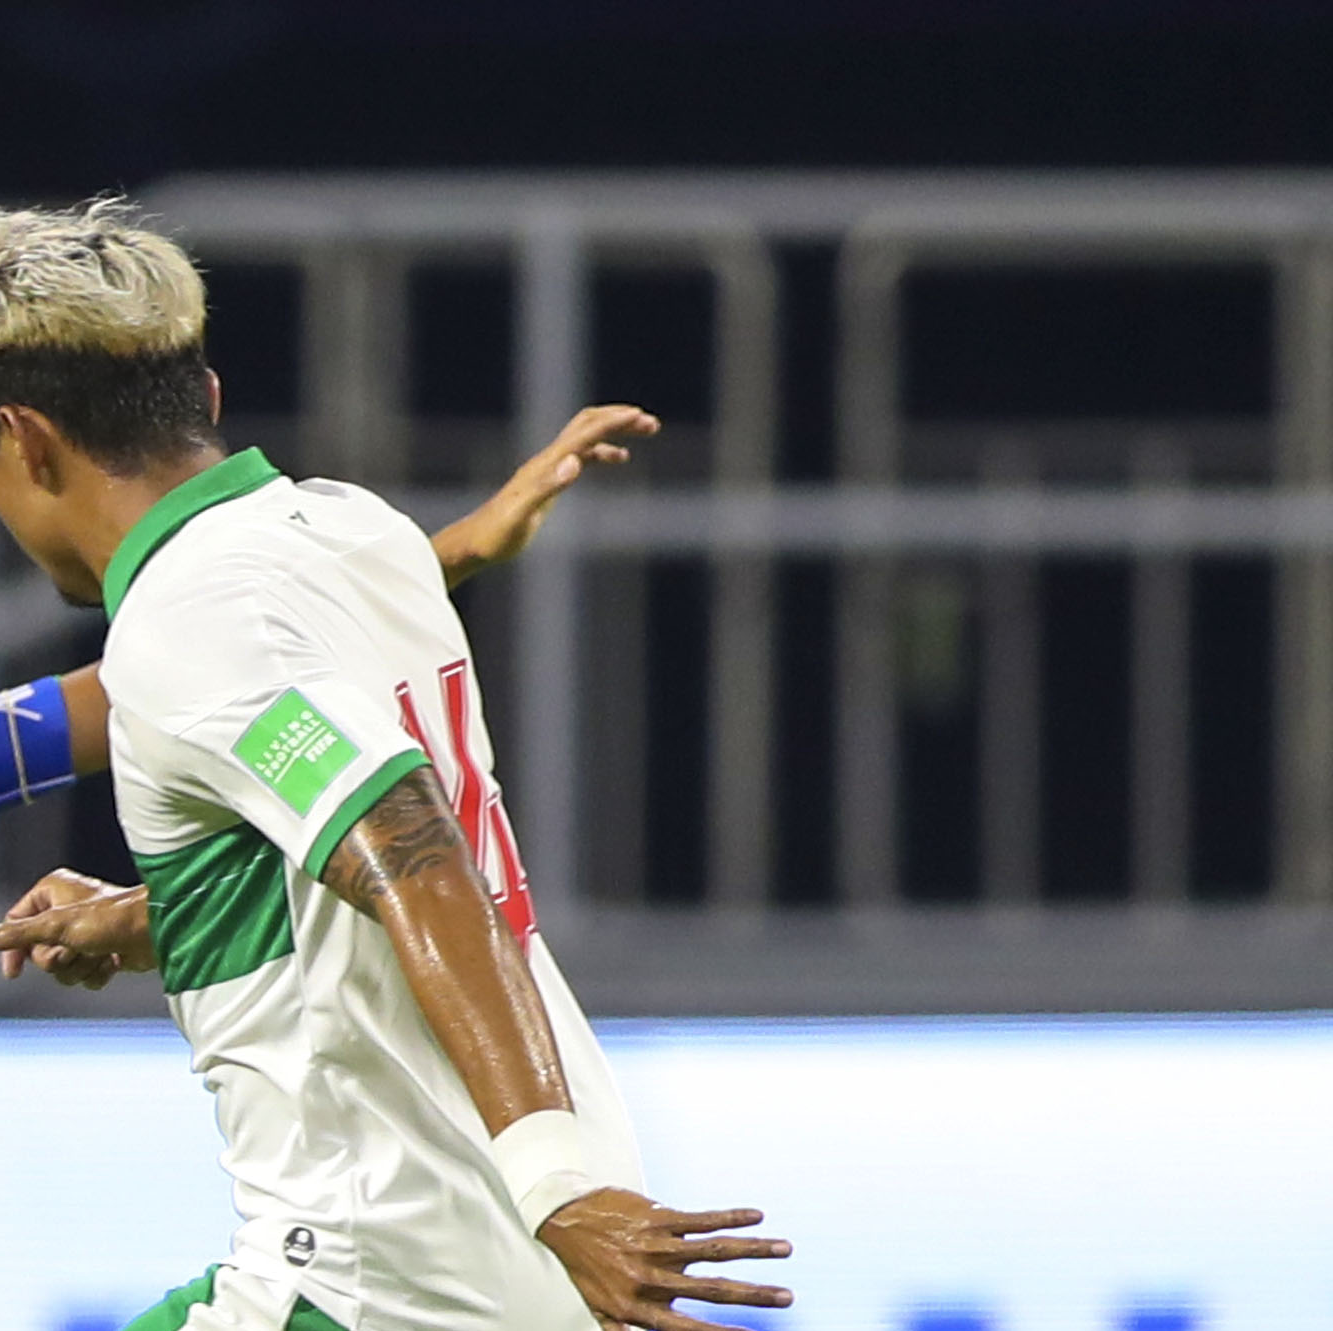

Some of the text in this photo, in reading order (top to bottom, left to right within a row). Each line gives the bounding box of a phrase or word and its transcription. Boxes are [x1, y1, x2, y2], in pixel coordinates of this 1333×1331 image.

[254, 709, 314, 771] LIVING
[263, 718, 322, 779] FOOTBALL
[303, 730, 339, 764] FIFA
